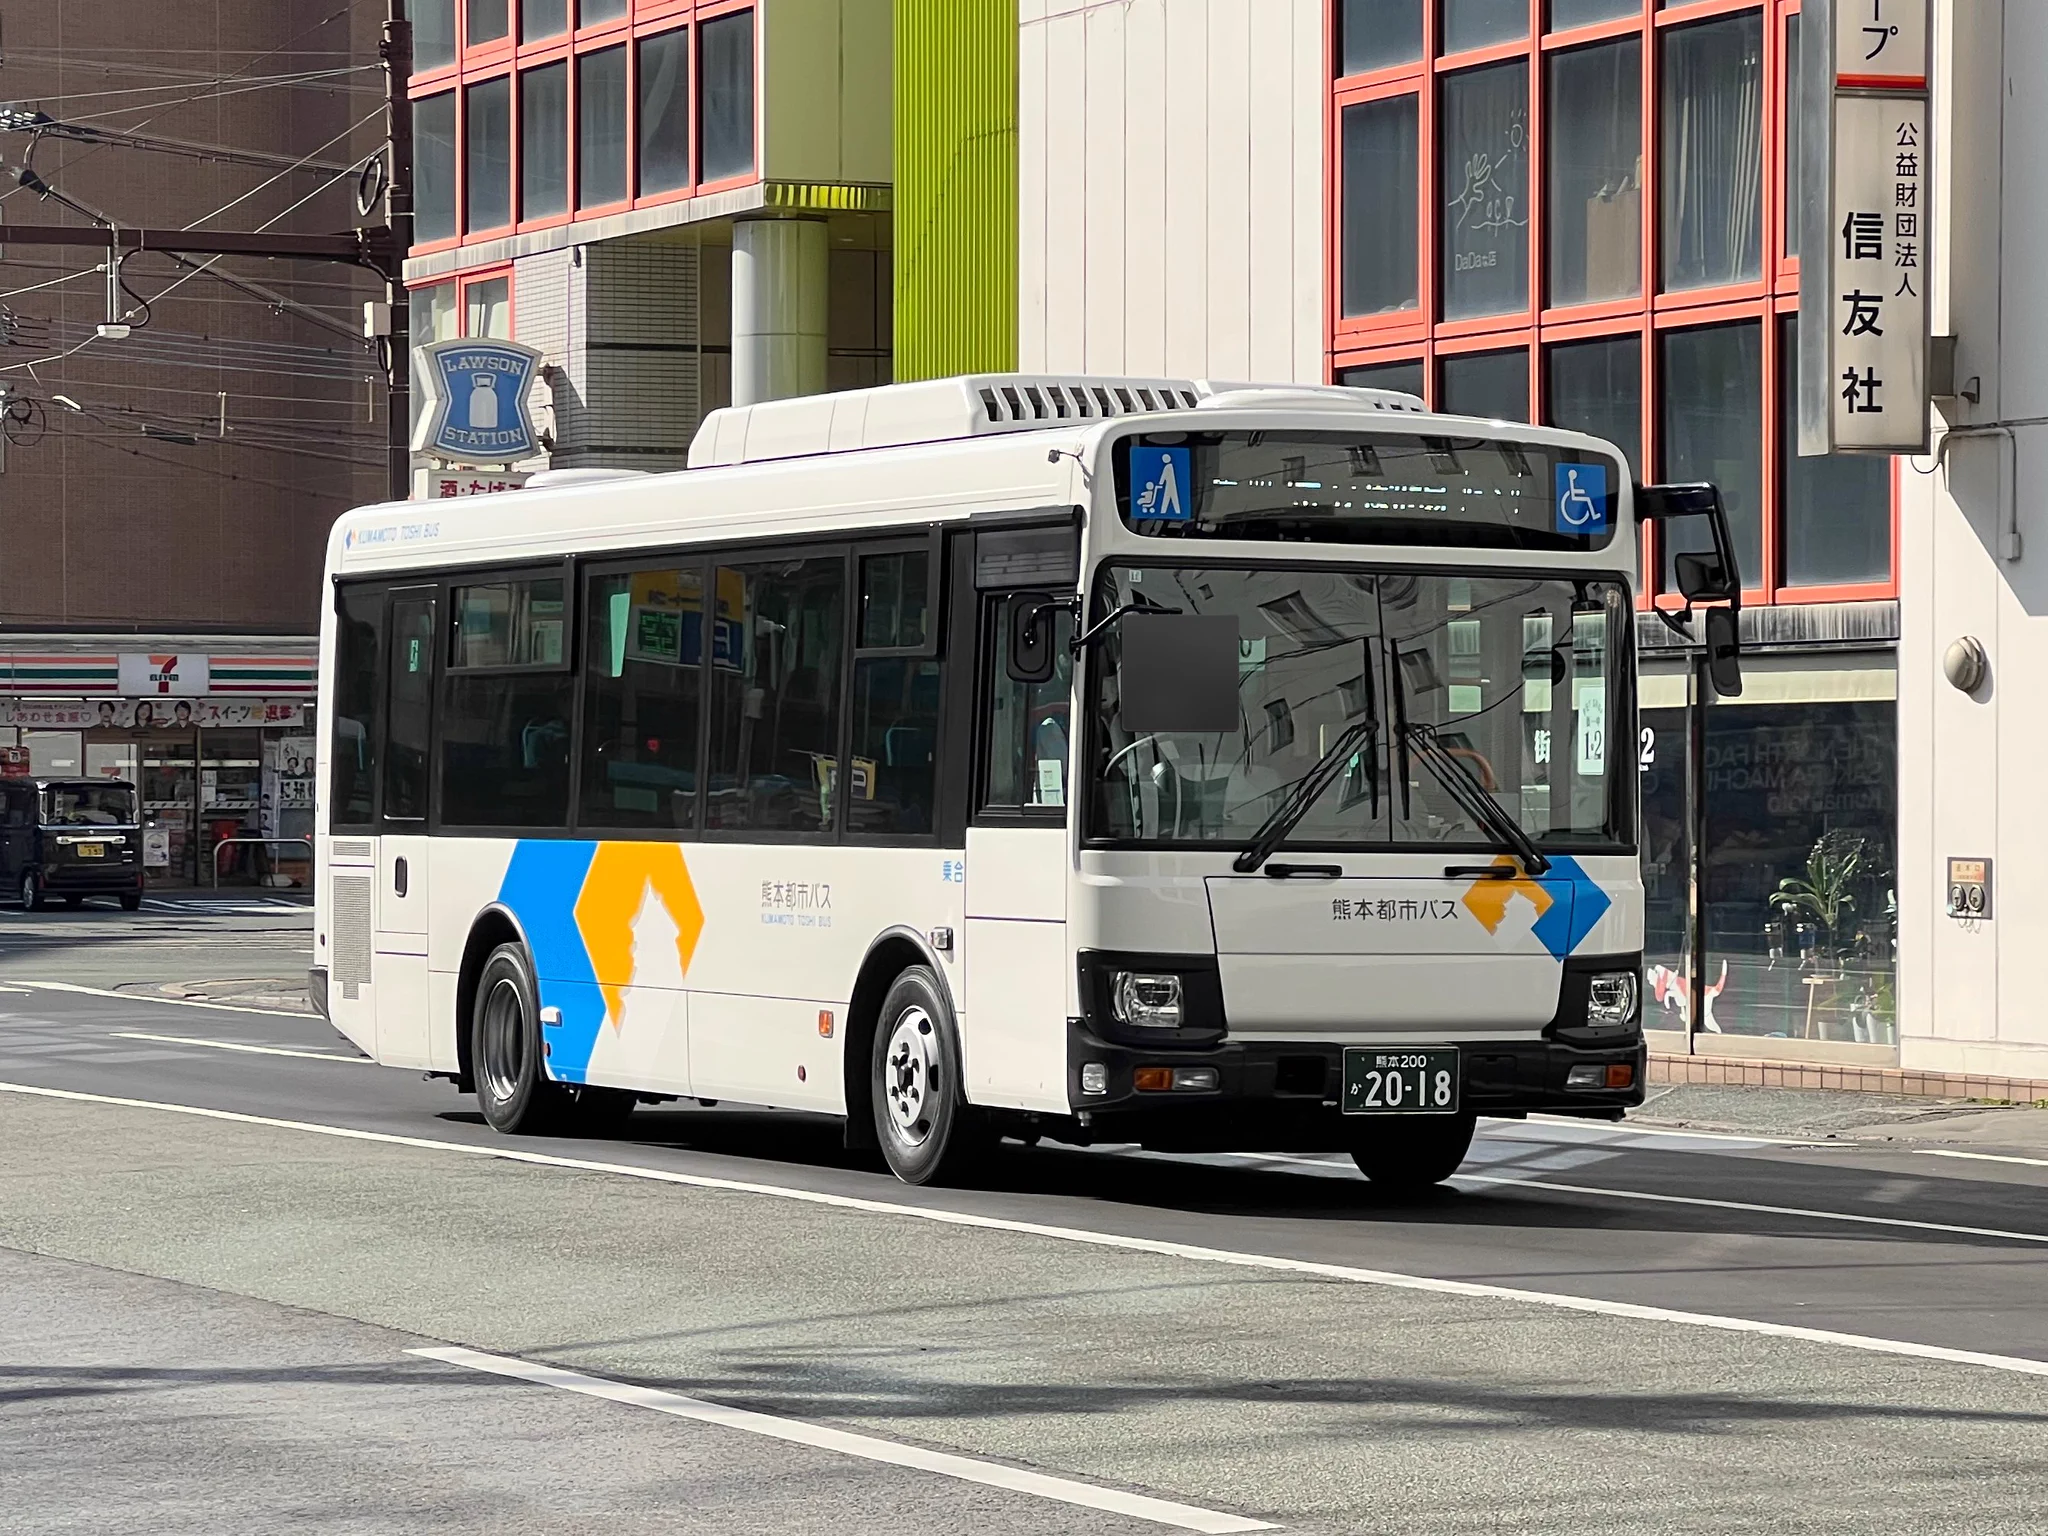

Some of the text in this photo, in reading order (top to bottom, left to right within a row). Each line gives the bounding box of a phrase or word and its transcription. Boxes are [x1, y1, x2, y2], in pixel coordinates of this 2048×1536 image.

[1894, 121, 1918, 298] 公益財団法人
[1841, 210, 1885, 415] 信友社
[444, 355, 524, 376] LAWSON
[444, 426, 523, 446] STATION
[424, 522, 440, 538] BUS
[761, 880, 832, 911] 熊本都市バス
[761, 914, 832, 928] KUMAMOTO TOSHI BUS
[1331, 898, 1459, 922] 熊本都市バス
[1365, 1070, 1451, 1107] 20-18
